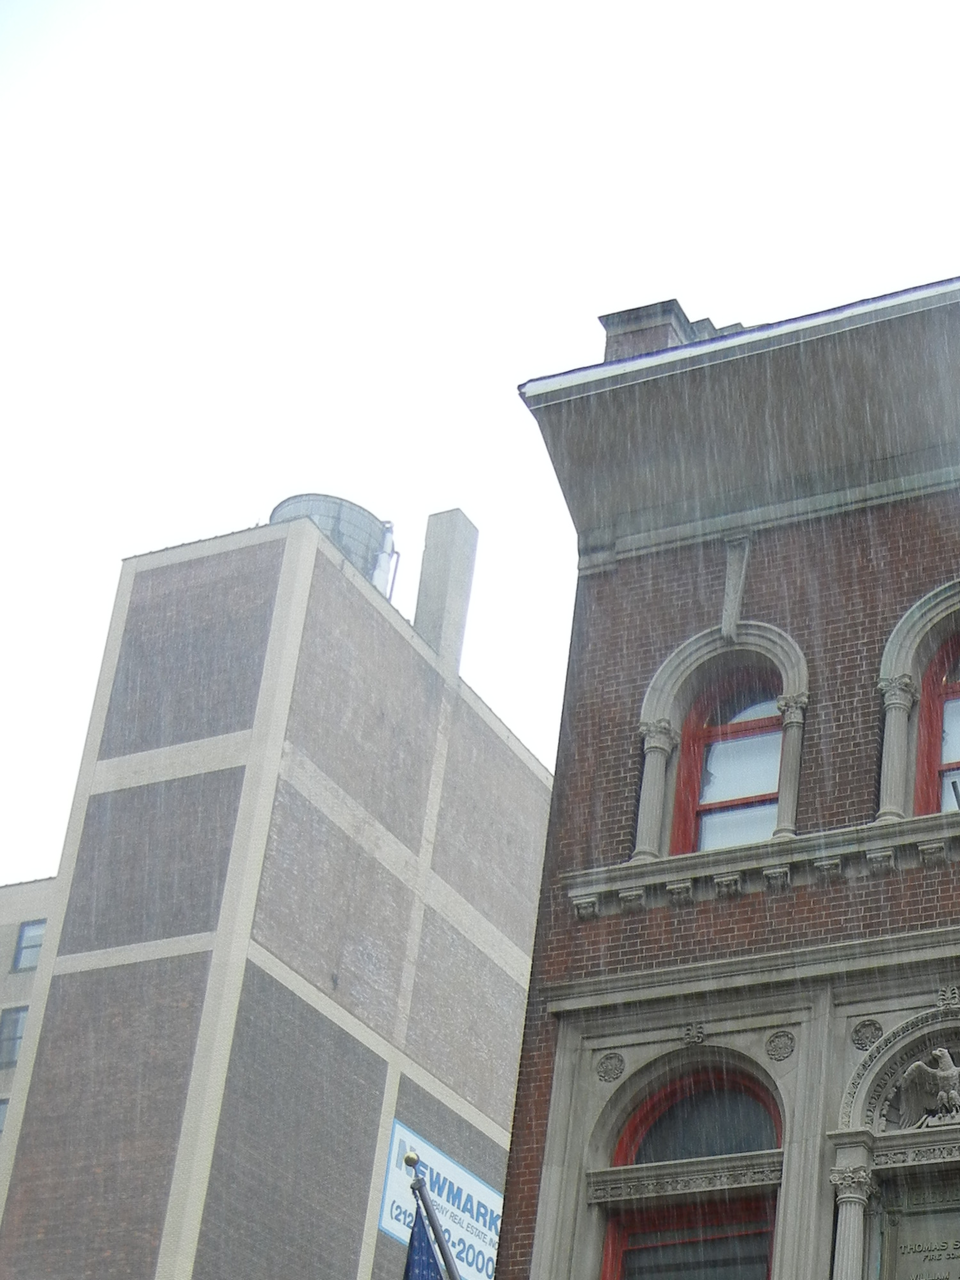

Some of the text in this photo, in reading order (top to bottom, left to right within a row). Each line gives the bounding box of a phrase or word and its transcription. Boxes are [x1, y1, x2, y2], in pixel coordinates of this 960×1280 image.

[390, 1200, 414, 1230] (212
[449, 1211, 465, 1230] REAL
[899, 1241, 949, 1255] THOMAS
[923, 1253, 943, 1262] FIRE
